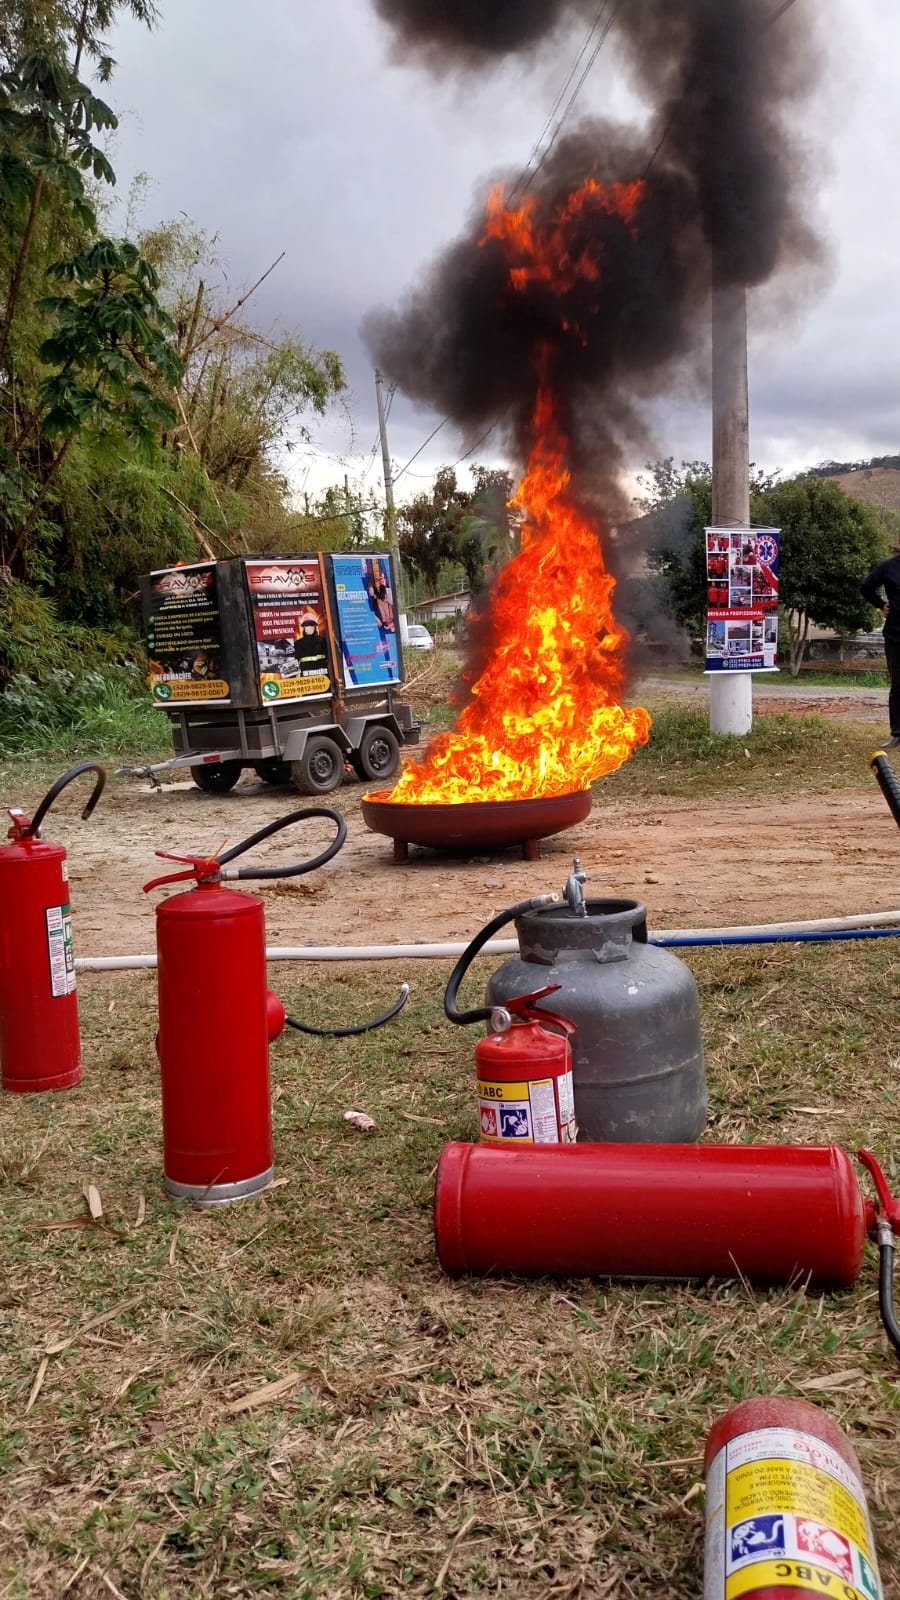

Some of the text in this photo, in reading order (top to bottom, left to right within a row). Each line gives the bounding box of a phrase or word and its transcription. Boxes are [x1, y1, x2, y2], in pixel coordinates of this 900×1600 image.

[250, 573, 315, 585] BRAVOS
[483, 1087, 503, 1098] ABC
[775, 1563, 832, 1587] ABC
